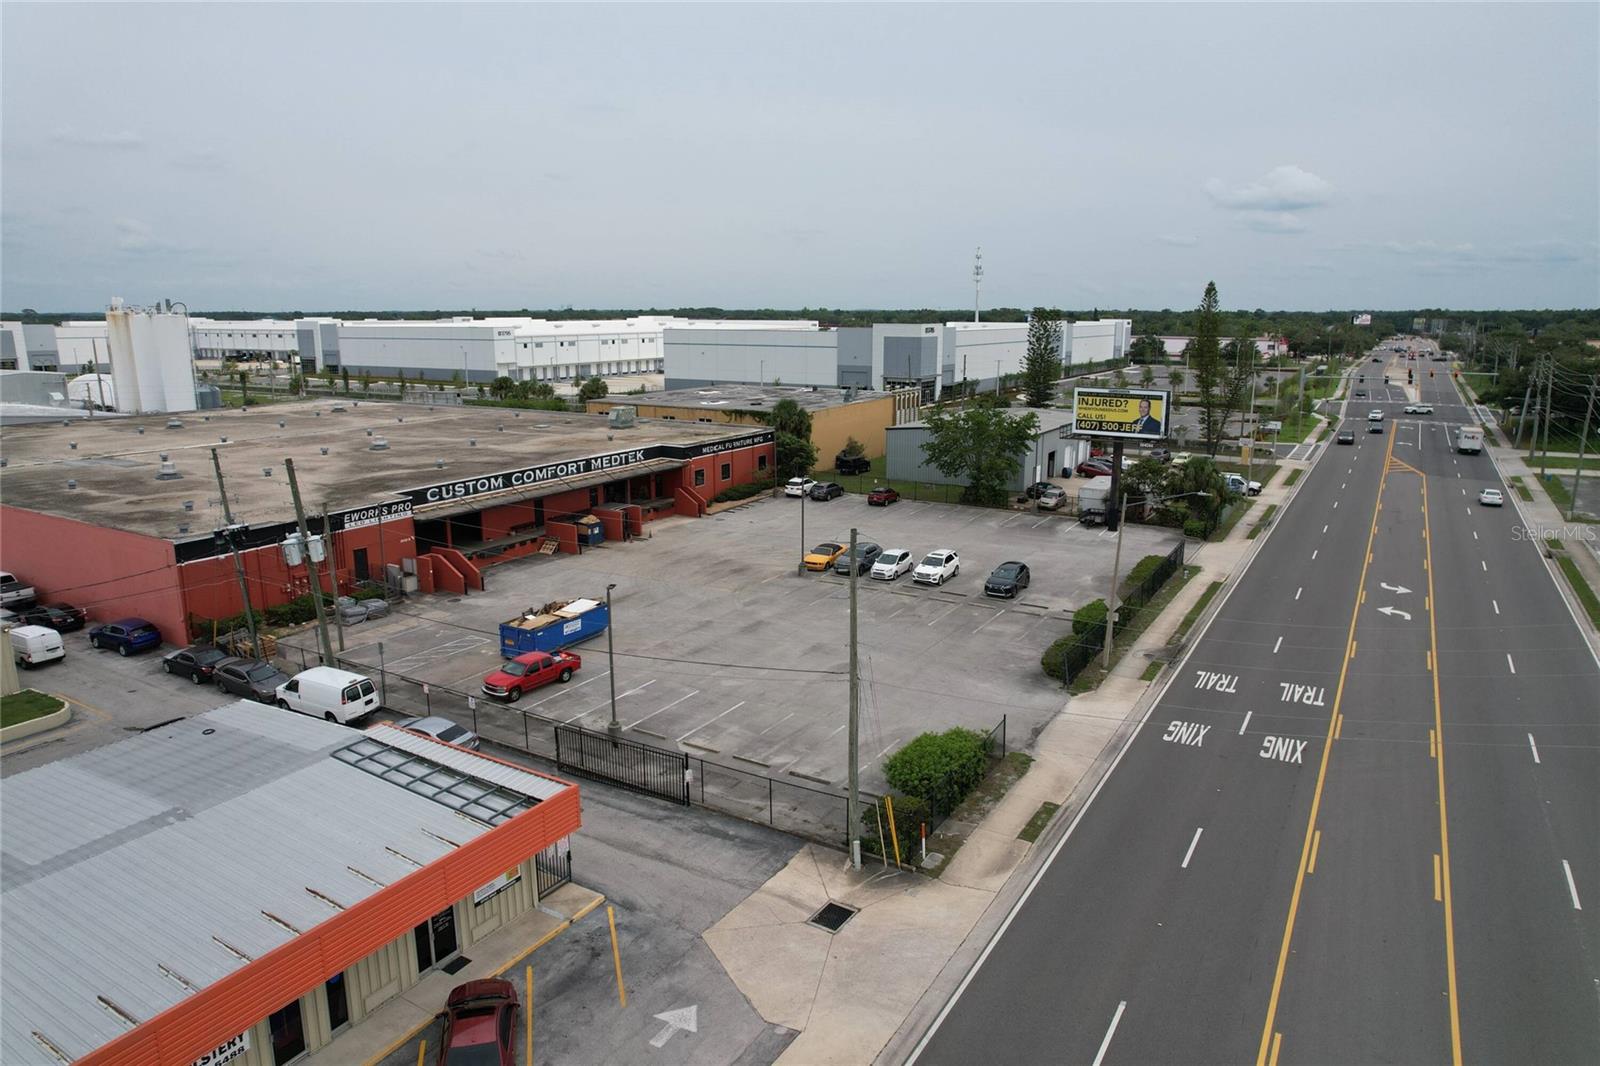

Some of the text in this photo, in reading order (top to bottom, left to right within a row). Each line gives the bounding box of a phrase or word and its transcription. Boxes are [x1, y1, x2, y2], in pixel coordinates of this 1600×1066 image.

[1078, 397, 1128, 408] INJURED?
[1077, 420, 1100, 430] (407)
[702, 444, 725, 453] MEDICAL
[427, 450, 645, 501] CUSTOM COMFORT MEDTEK
[391, 501, 412, 514] PRO
[1194, 670, 1239, 693] TRAIL
[1279, 682, 1325, 706] TRAIL
[1162, 720, 1211, 747] XING
[1259, 735, 1308, 764] XING
